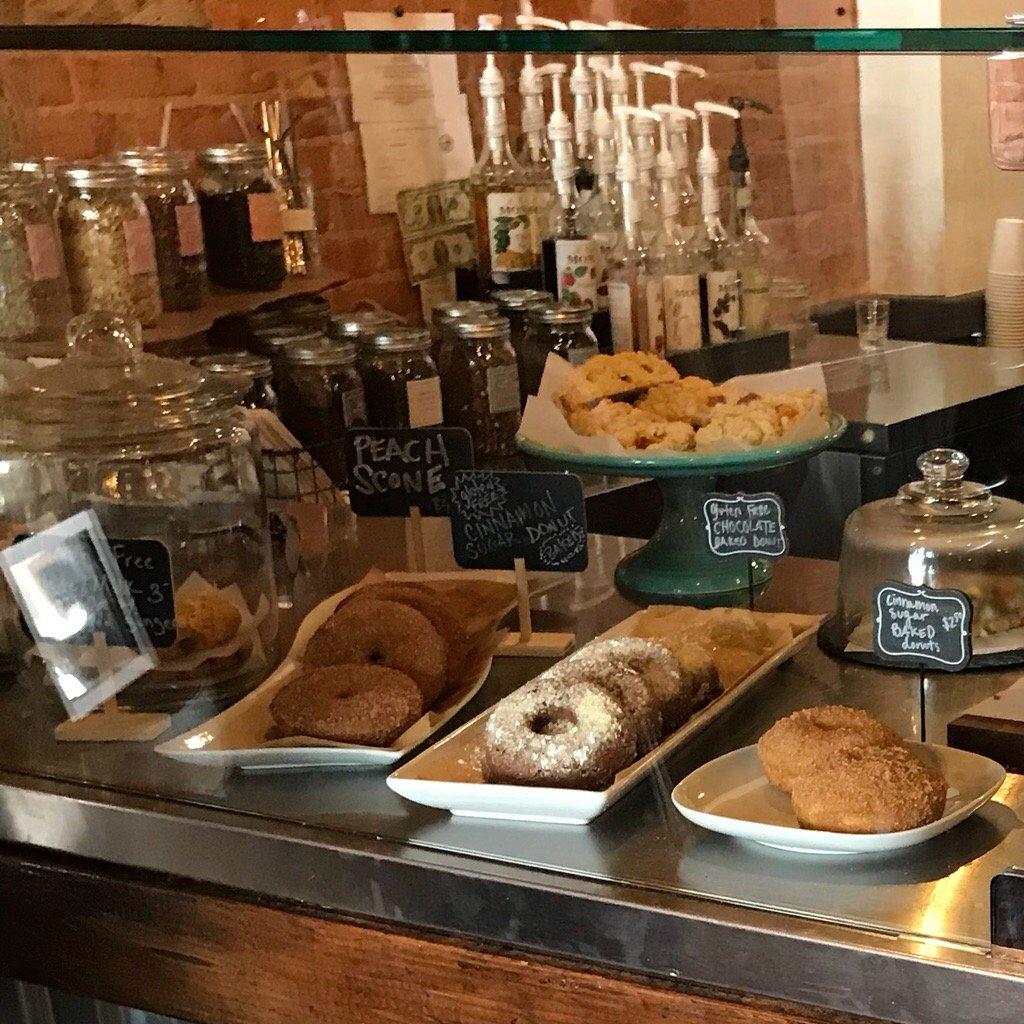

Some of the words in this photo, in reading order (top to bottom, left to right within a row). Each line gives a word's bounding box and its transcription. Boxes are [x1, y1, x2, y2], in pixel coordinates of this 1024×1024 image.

[353, 433, 450, 467] PEACH
[352, 463, 447, 495] SCONE
[464, 489, 558, 542] CINNAMON
[525, 505, 577, 545] DONUT
[713, 520, 776, 536] CHOCOLATE
[891, 621, 936, 639] BAKED
[901, 635, 941, 653] donuts
